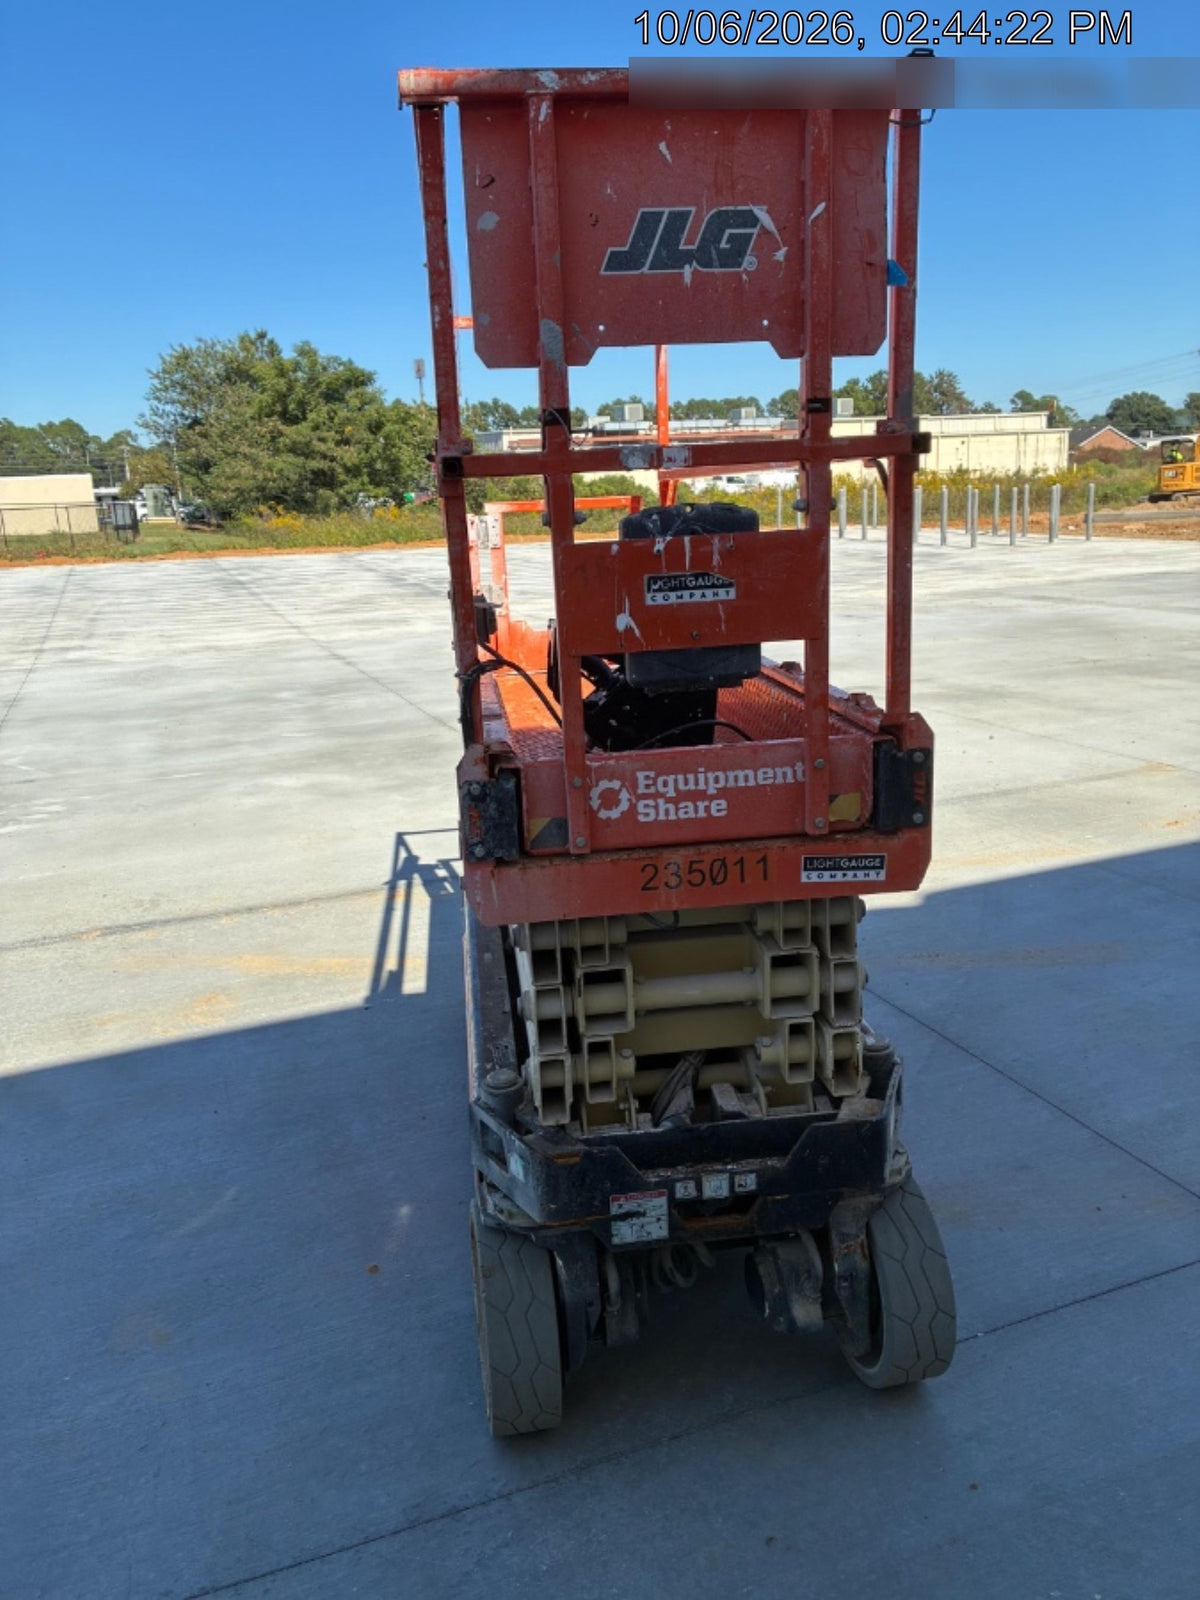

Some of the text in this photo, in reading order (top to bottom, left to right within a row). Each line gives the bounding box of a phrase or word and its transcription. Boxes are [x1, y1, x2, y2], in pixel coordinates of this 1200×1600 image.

[600, 205, 768, 275] JLG
[636, 762, 806, 797] Equipment
[636, 798, 728, 822] Share
[806, 858, 881, 868] LIGHTGAUGE
[806, 871, 881, 880] COMPANY
